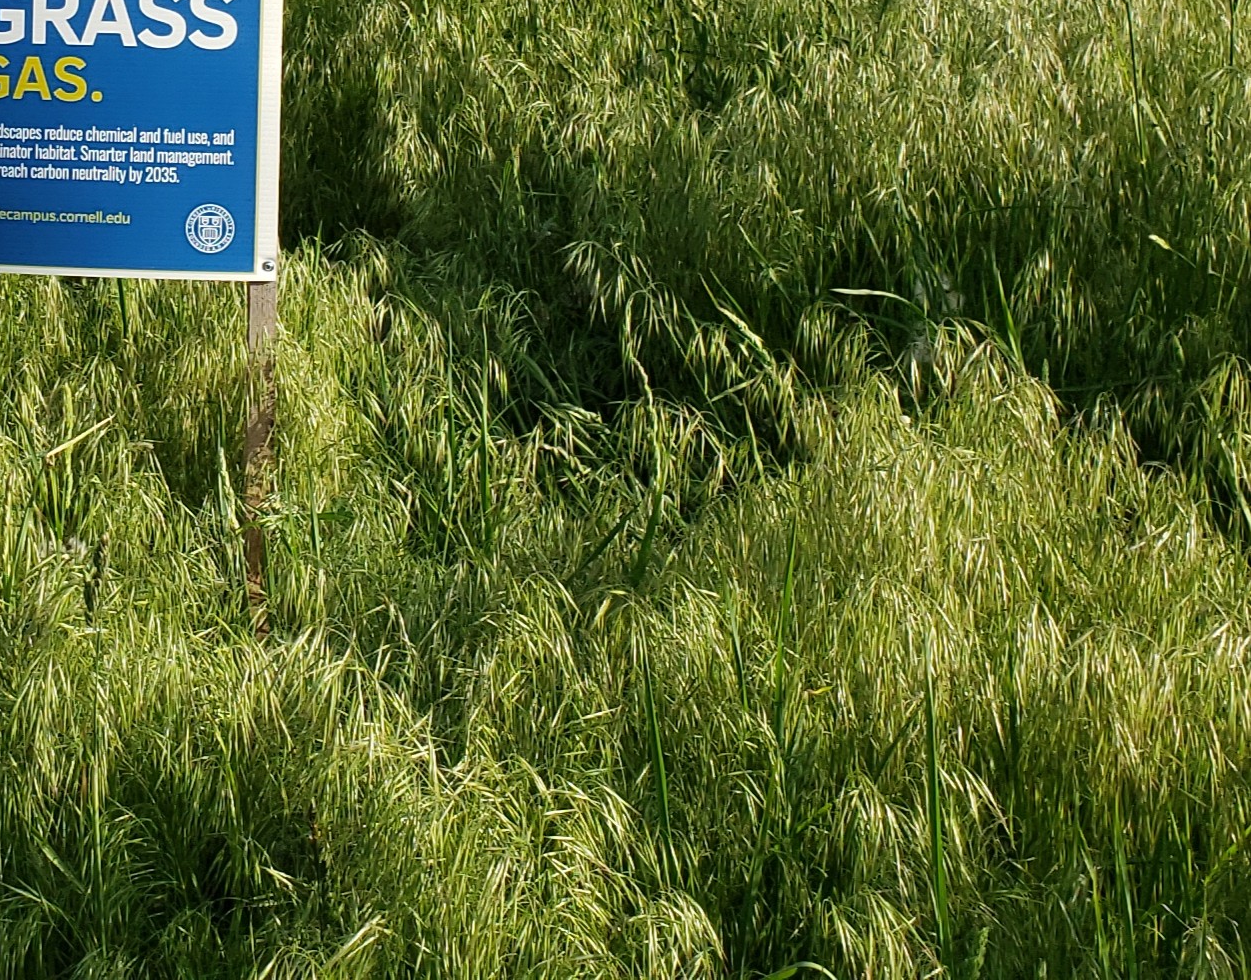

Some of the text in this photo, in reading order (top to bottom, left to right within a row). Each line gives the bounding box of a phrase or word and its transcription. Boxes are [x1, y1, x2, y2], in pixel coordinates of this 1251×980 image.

[44, 125, 83, 141] reduce
[85, 126, 137, 143] chemical
[139, 128, 161, 144] and
[163, 128, 185, 144] fuel
[187, 131, 211, 146] use,
[213, 129, 235, 146] and
[35, 144, 78, 161] habitat.
[80, 146, 128, 162] Smarter
[129, 147, 154, 163] land
[157, 150, 235, 167] management.
[30, 164, 69, 180] carbon
[71, 165, 126, 184] neutrality
[129, 166, 143, 185] by
[145, 167, 180, 183] 2035.
